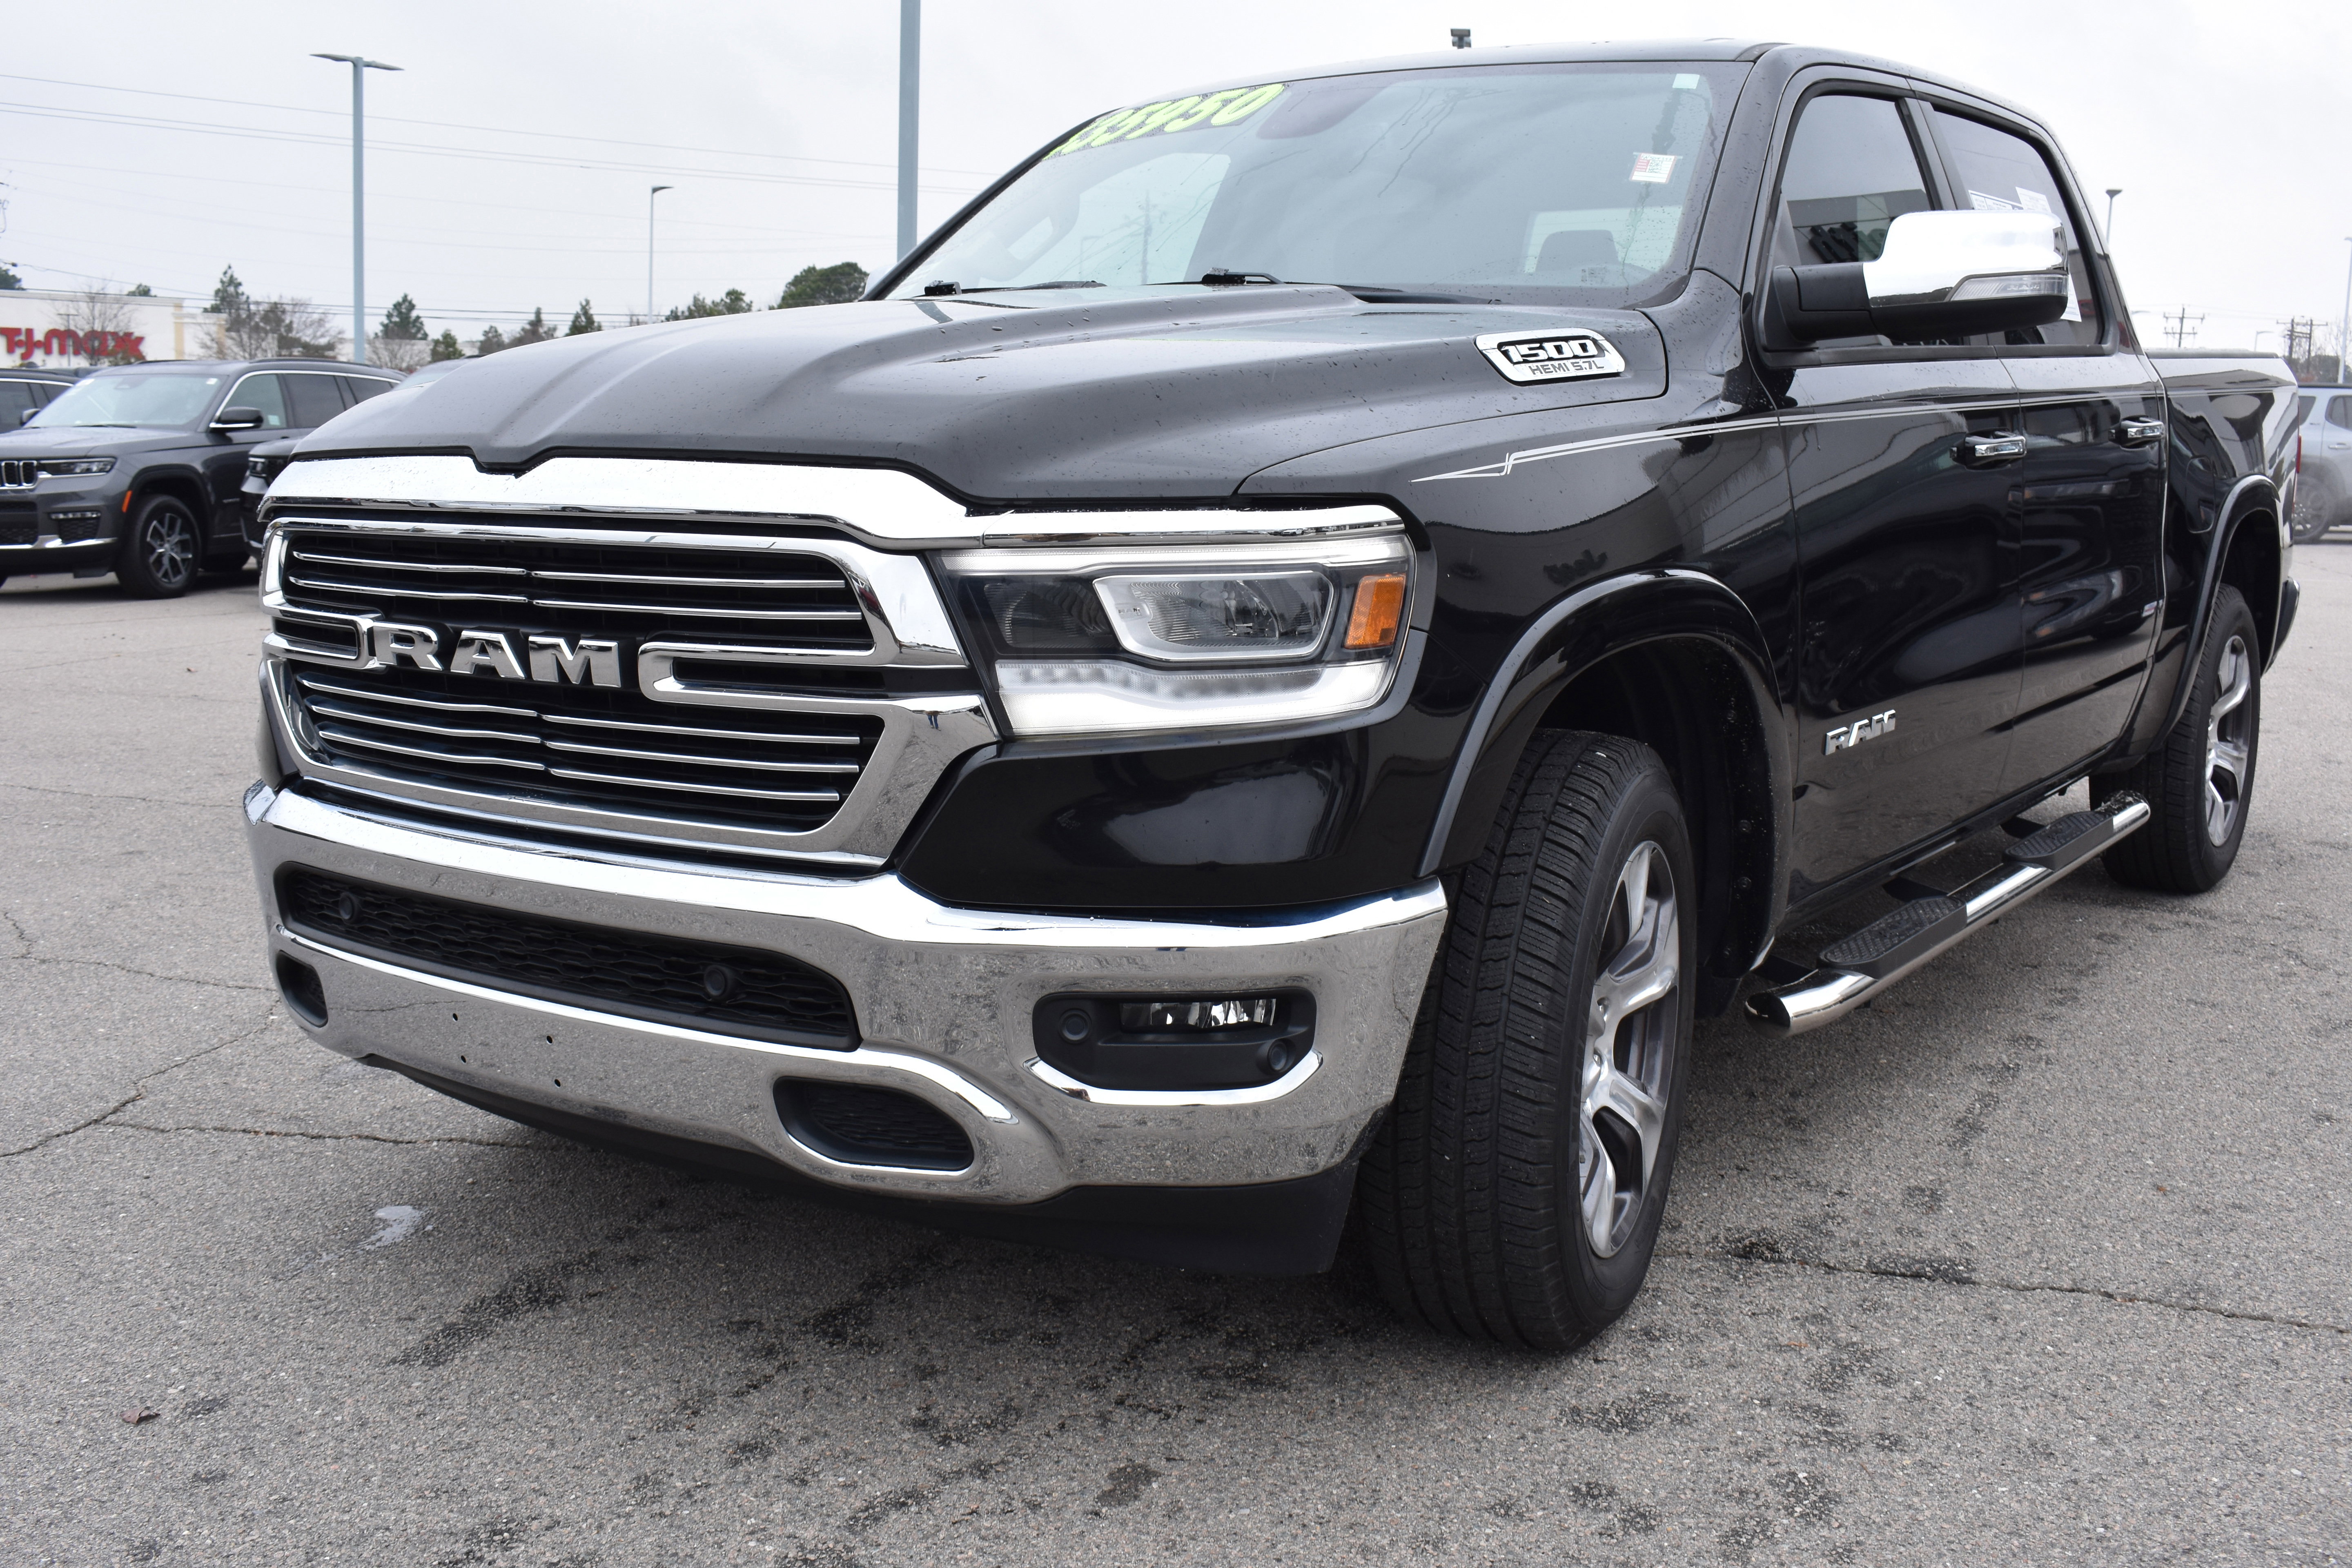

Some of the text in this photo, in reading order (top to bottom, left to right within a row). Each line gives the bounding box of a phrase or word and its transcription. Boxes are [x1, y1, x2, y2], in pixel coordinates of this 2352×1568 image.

[1501, 339, 1598, 363] 1500
[1528, 360, 1604, 375] HEMI 5.7L
[373, 621, 621, 688] RAM
[1824, 709, 1896, 755] RAM
